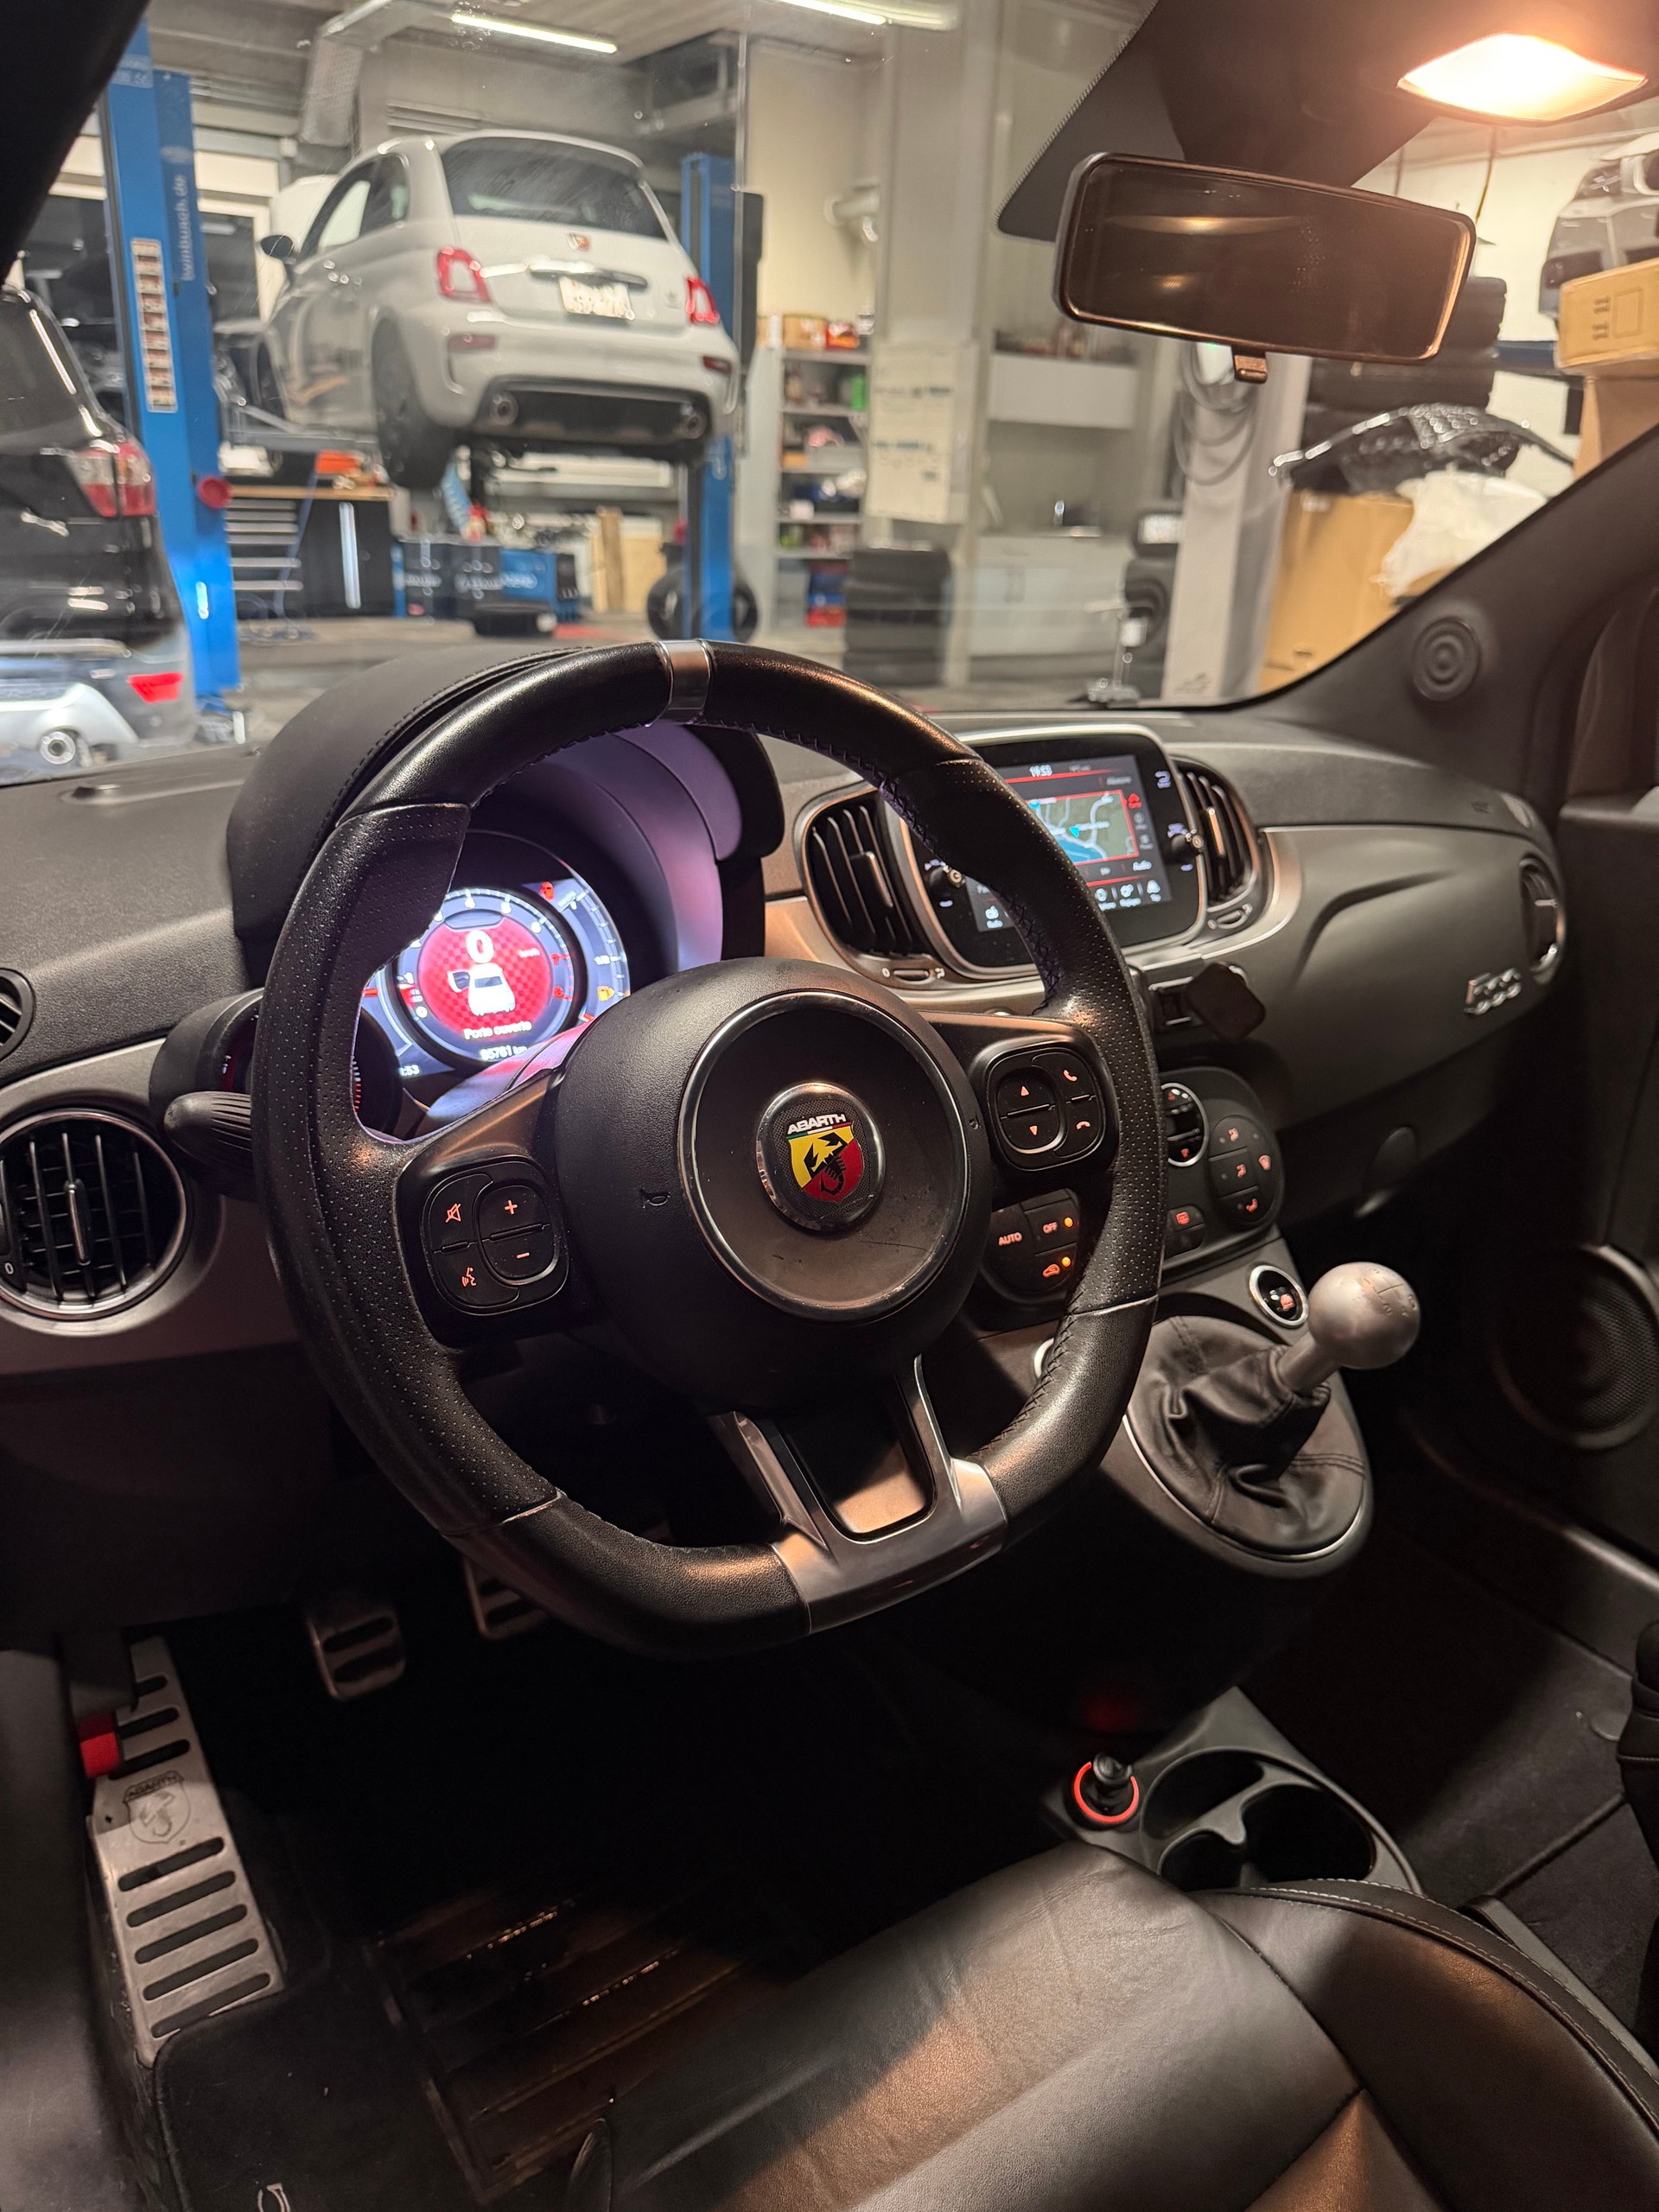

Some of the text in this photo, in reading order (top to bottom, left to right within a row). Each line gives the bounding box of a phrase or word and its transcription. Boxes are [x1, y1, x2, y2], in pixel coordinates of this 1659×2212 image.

[466, 930, 494, 964] 0
[787, 1113, 847, 1135] ABARTH
[1042, 1222, 1058, 1234] OFF
[998, 1231, 1022, 1246] AUTO
